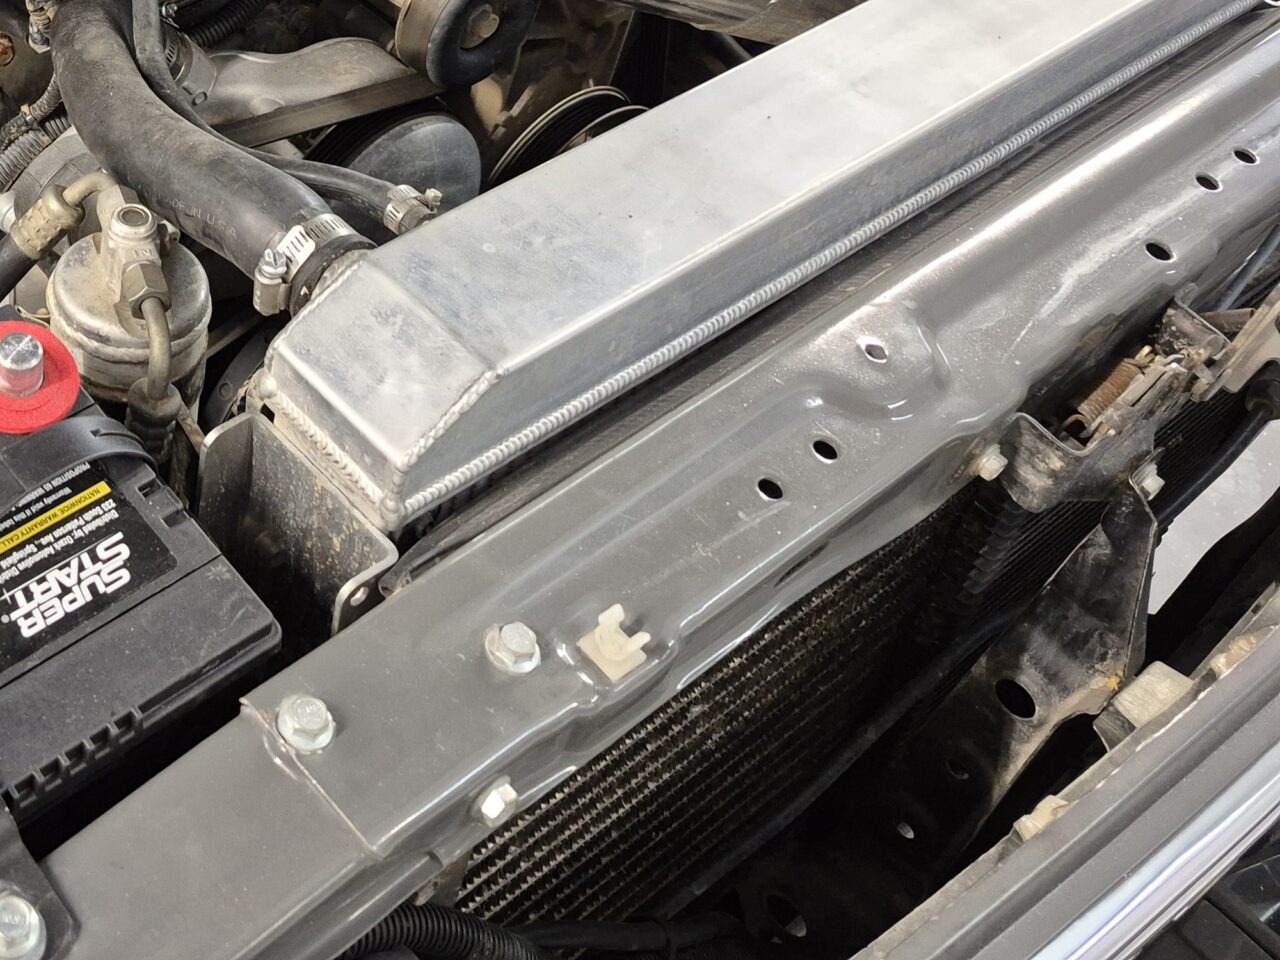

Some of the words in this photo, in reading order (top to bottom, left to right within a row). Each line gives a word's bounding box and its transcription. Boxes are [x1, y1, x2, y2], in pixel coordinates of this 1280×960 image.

[49, 460, 91, 488] PROPOSITION
[40, 484, 72, 506] Warranty
[41, 481, 54, 492] 65
[28, 500, 45, 513] void
[56, 486, 101, 516] NATIONWIDE
[99, 497, 117, 512] 233
[11, 510, 27, 523] this
[17, 510, 59, 537] WARRANTY
[80, 505, 104, 522] South
[80, 508, 120, 535] Distributed
[50, 515, 86, 540] Patterson
[69, 527, 85, 541] by:
[51, 534, 74, 551] Ozark
[14, 544, 56, 572] Automotive
[9, 530, 129, 620] START
[16, 557, 129, 636] SUPER
